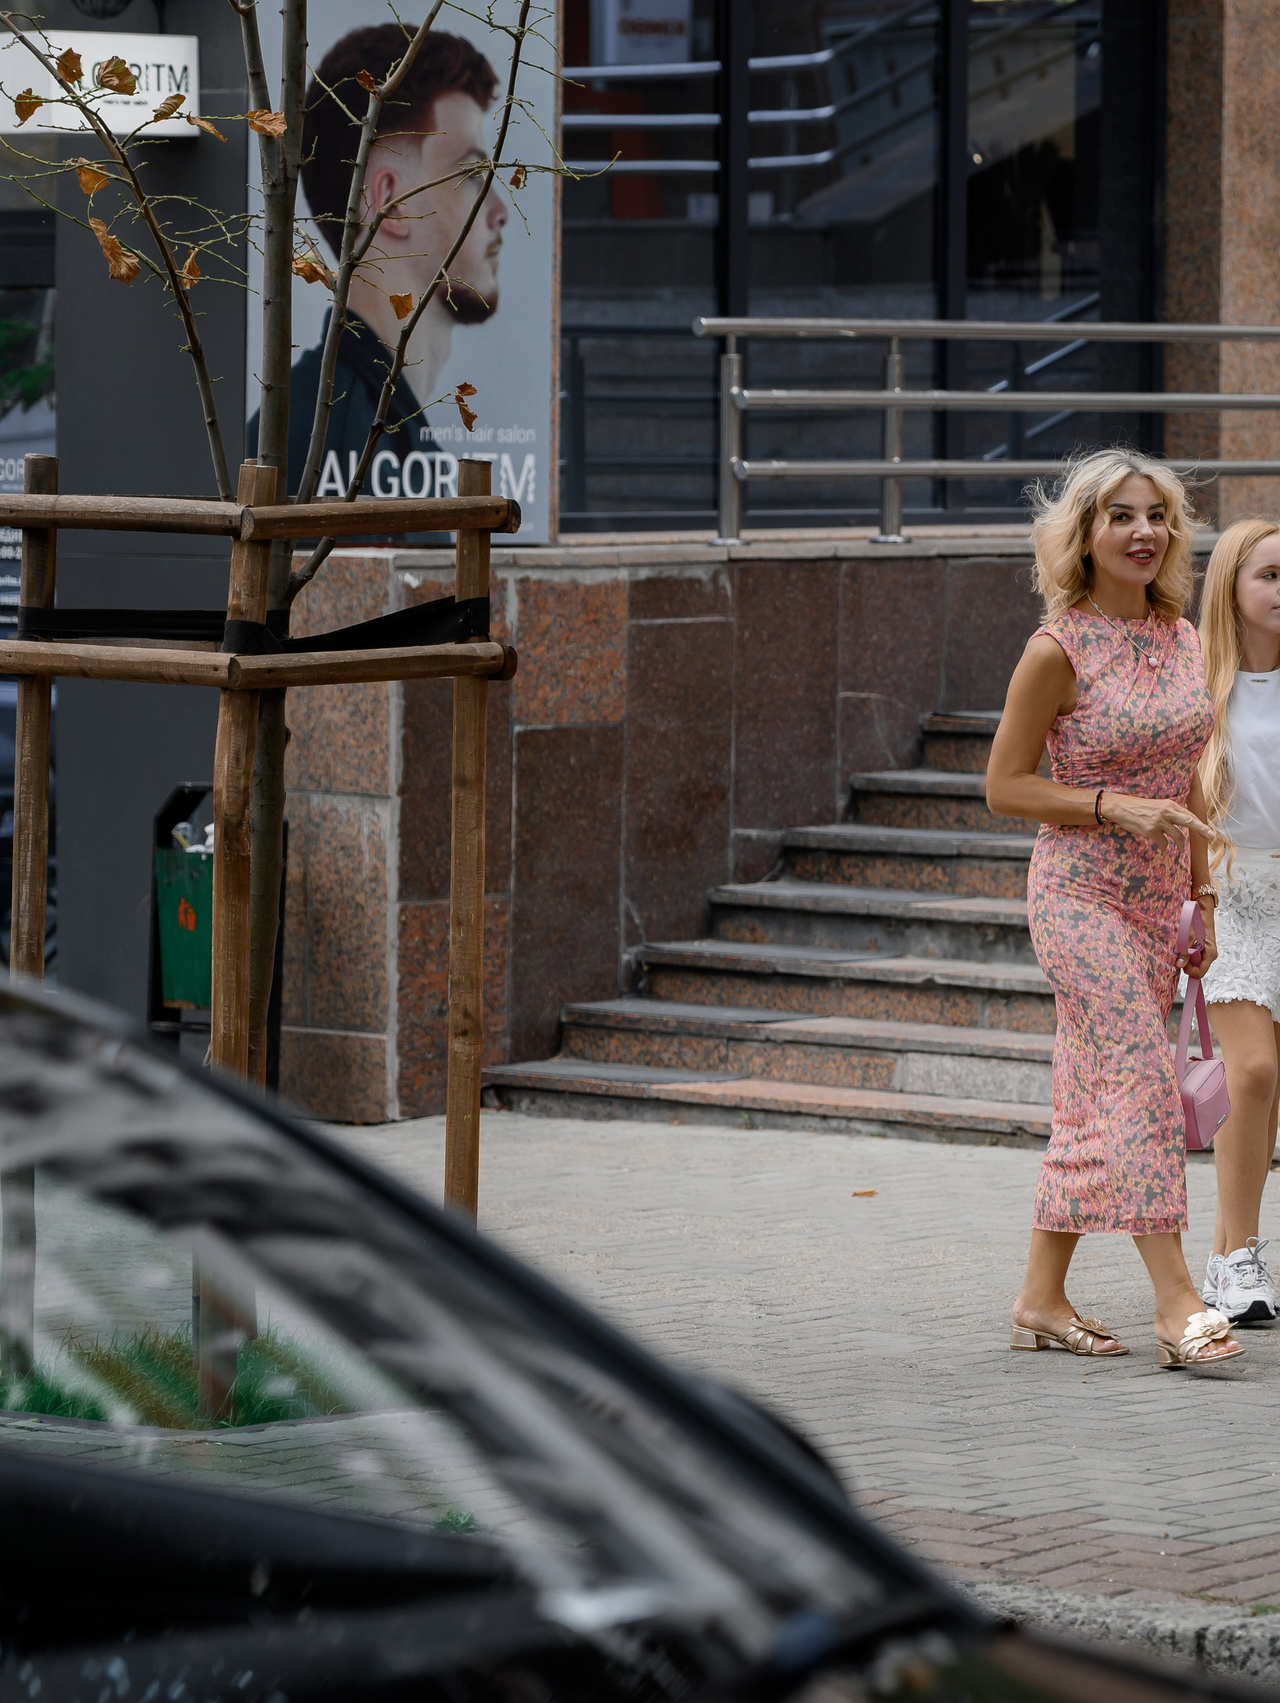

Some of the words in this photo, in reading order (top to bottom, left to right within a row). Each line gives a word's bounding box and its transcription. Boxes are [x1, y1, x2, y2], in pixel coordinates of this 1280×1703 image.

[420, 423, 463, 442] men's
[497, 424, 536, 443] salon
[316, 450, 536, 503] AGORM
